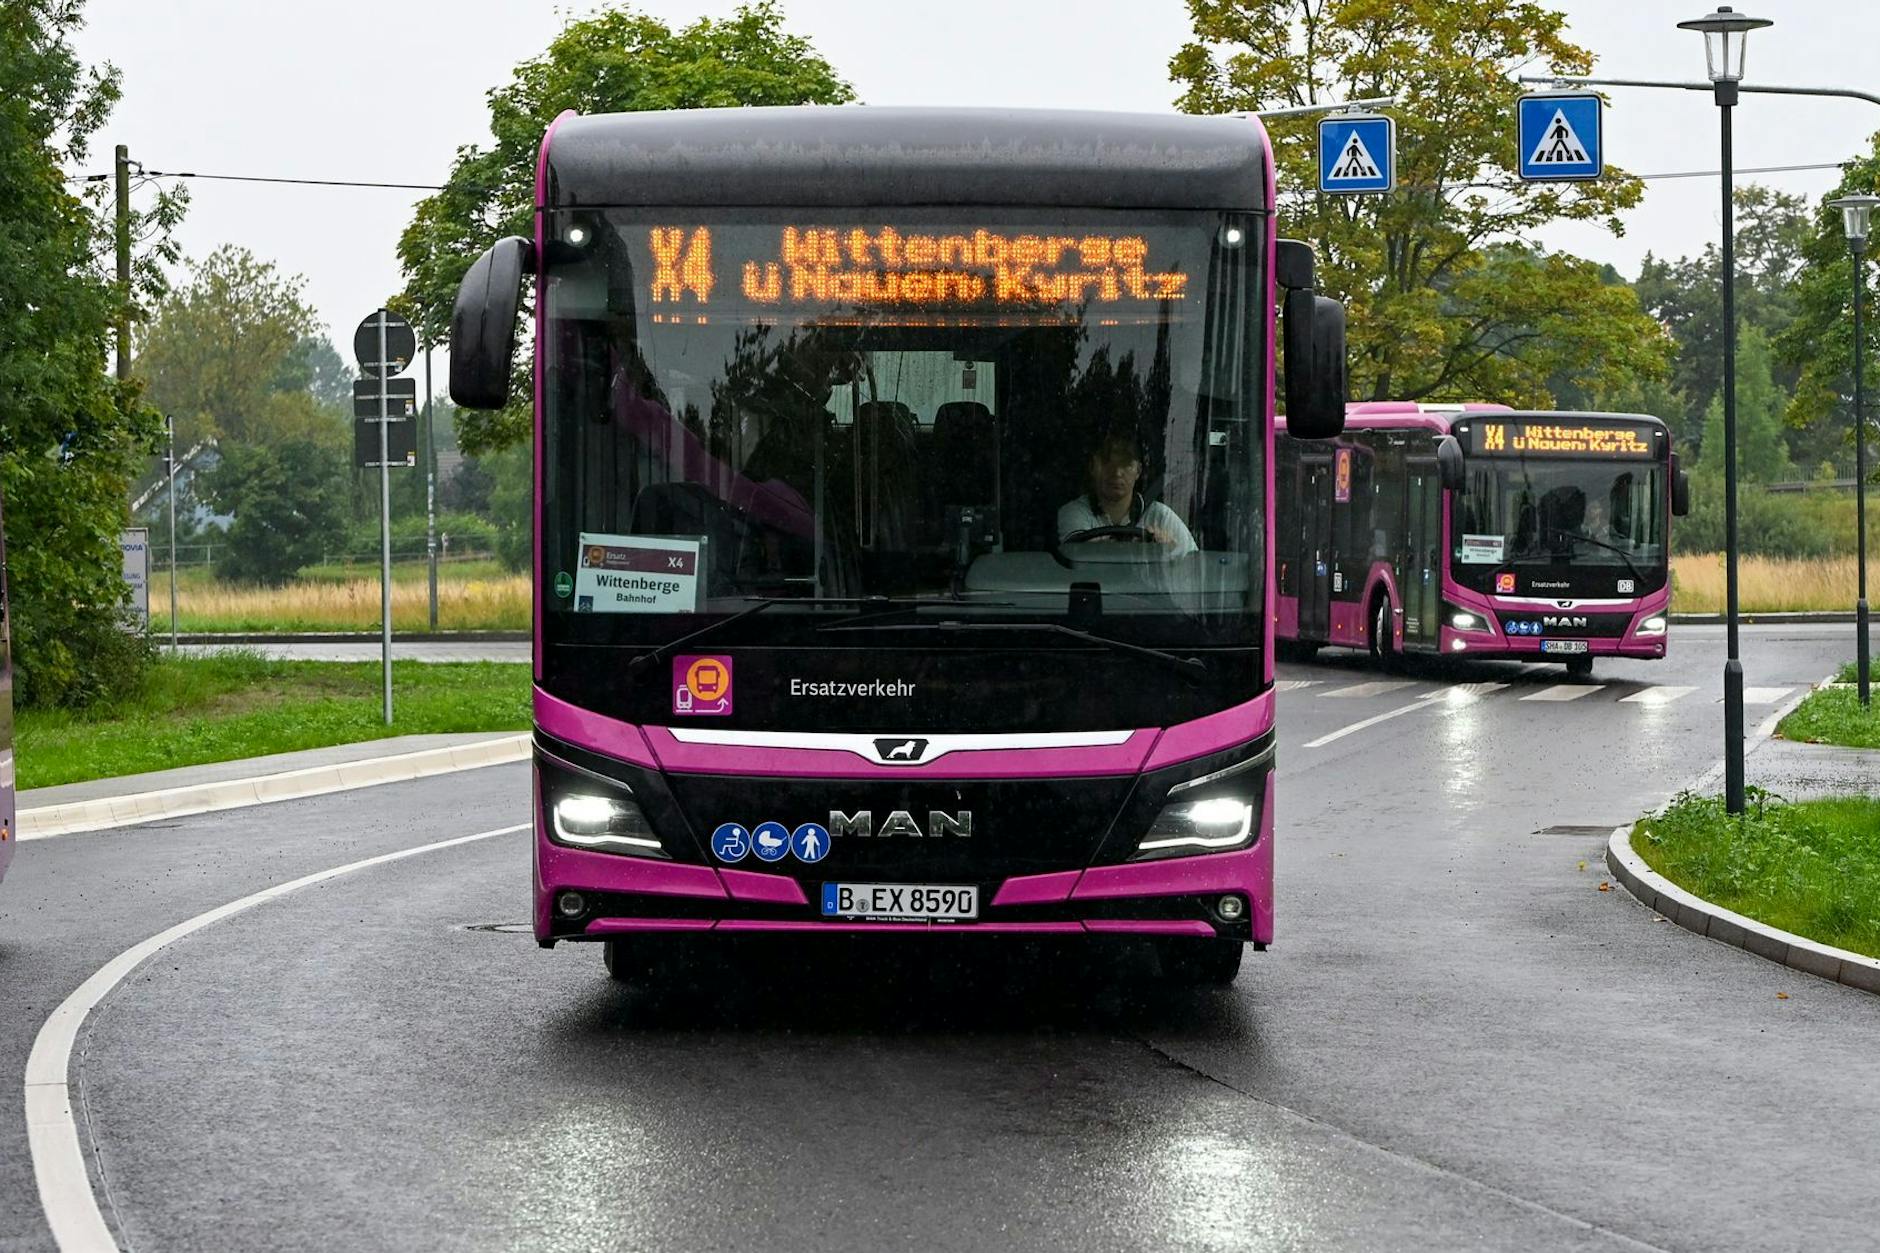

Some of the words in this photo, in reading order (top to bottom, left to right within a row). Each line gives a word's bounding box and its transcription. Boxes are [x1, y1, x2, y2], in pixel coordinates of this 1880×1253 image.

[783, 226, 1148, 266] Wittenberge
[651, 226, 714, 302] X4
[994, 264, 1188, 302] Kyritz
[1485, 424, 1505, 450] X4
[1525, 425, 1636, 440] Wittenberge
[1589, 438, 1649, 453] Kyritz
[667, 557, 684, 568] X4
[596, 574, 680, 595] Wittenberge
[1531, 580, 1570, 589] Ersatzverkehr
[1618, 580, 1633, 592] DB
[616, 593, 656, 604] Bahnhof
[1543, 616, 1587, 627] MAN
[790, 678, 916, 697] Ersatzverkehr
[829, 810, 972, 837] MAN
[839, 887, 854, 911] B
[872, 888, 905, 912] EX
[910, 889, 973, 913] 8590
